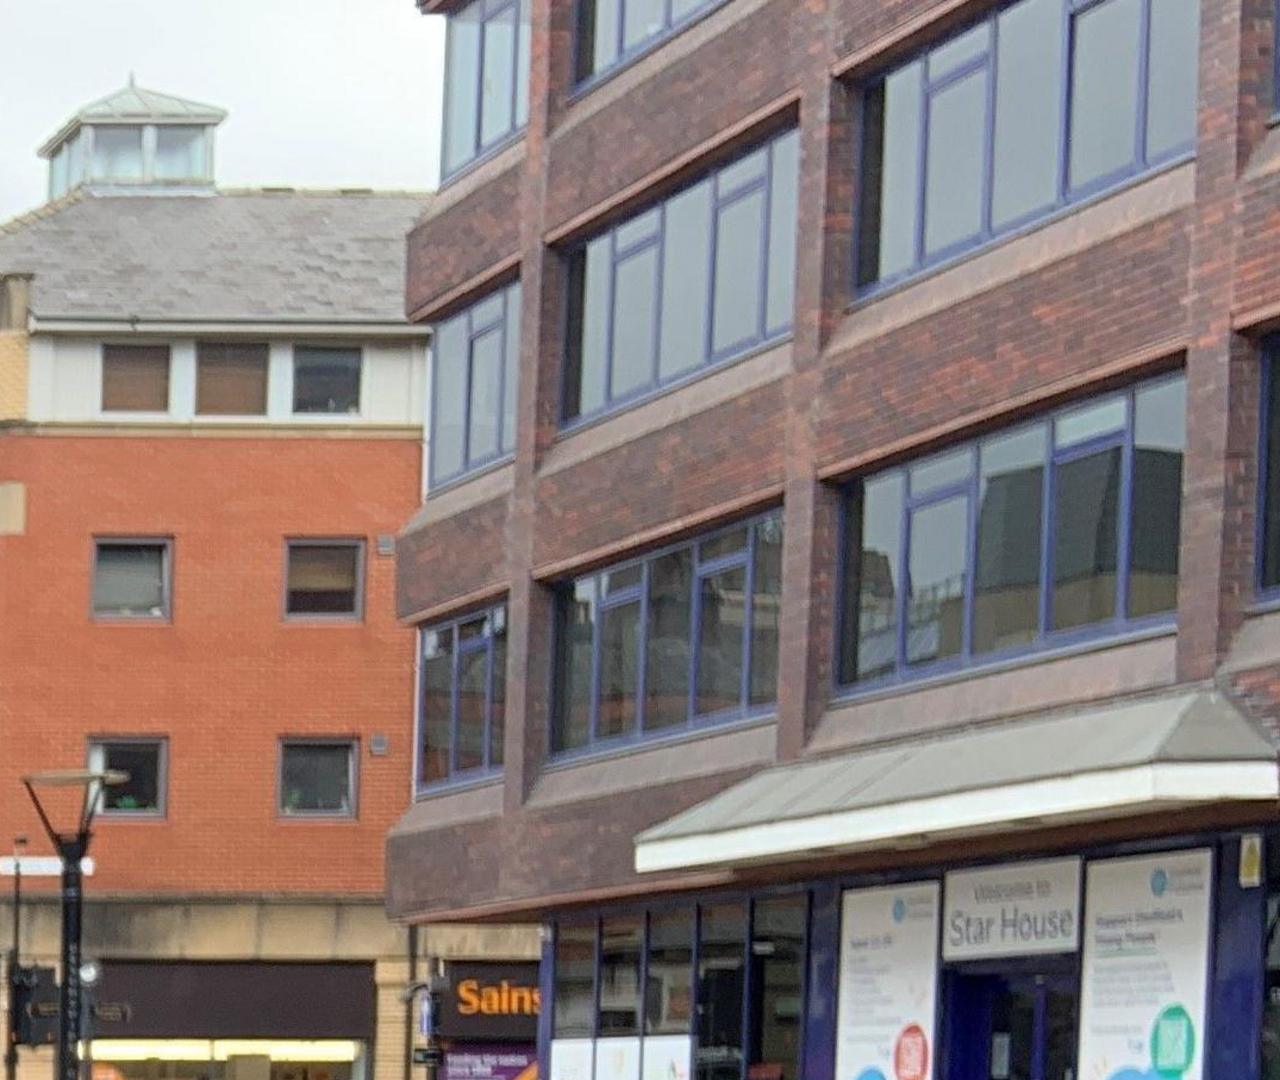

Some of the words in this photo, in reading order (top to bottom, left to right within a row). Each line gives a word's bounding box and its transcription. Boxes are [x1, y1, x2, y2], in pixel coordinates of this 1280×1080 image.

[950, 909, 995, 946] Star
[1000, 905, 1073, 941] House
[457, 979, 542, 1014] Sains
